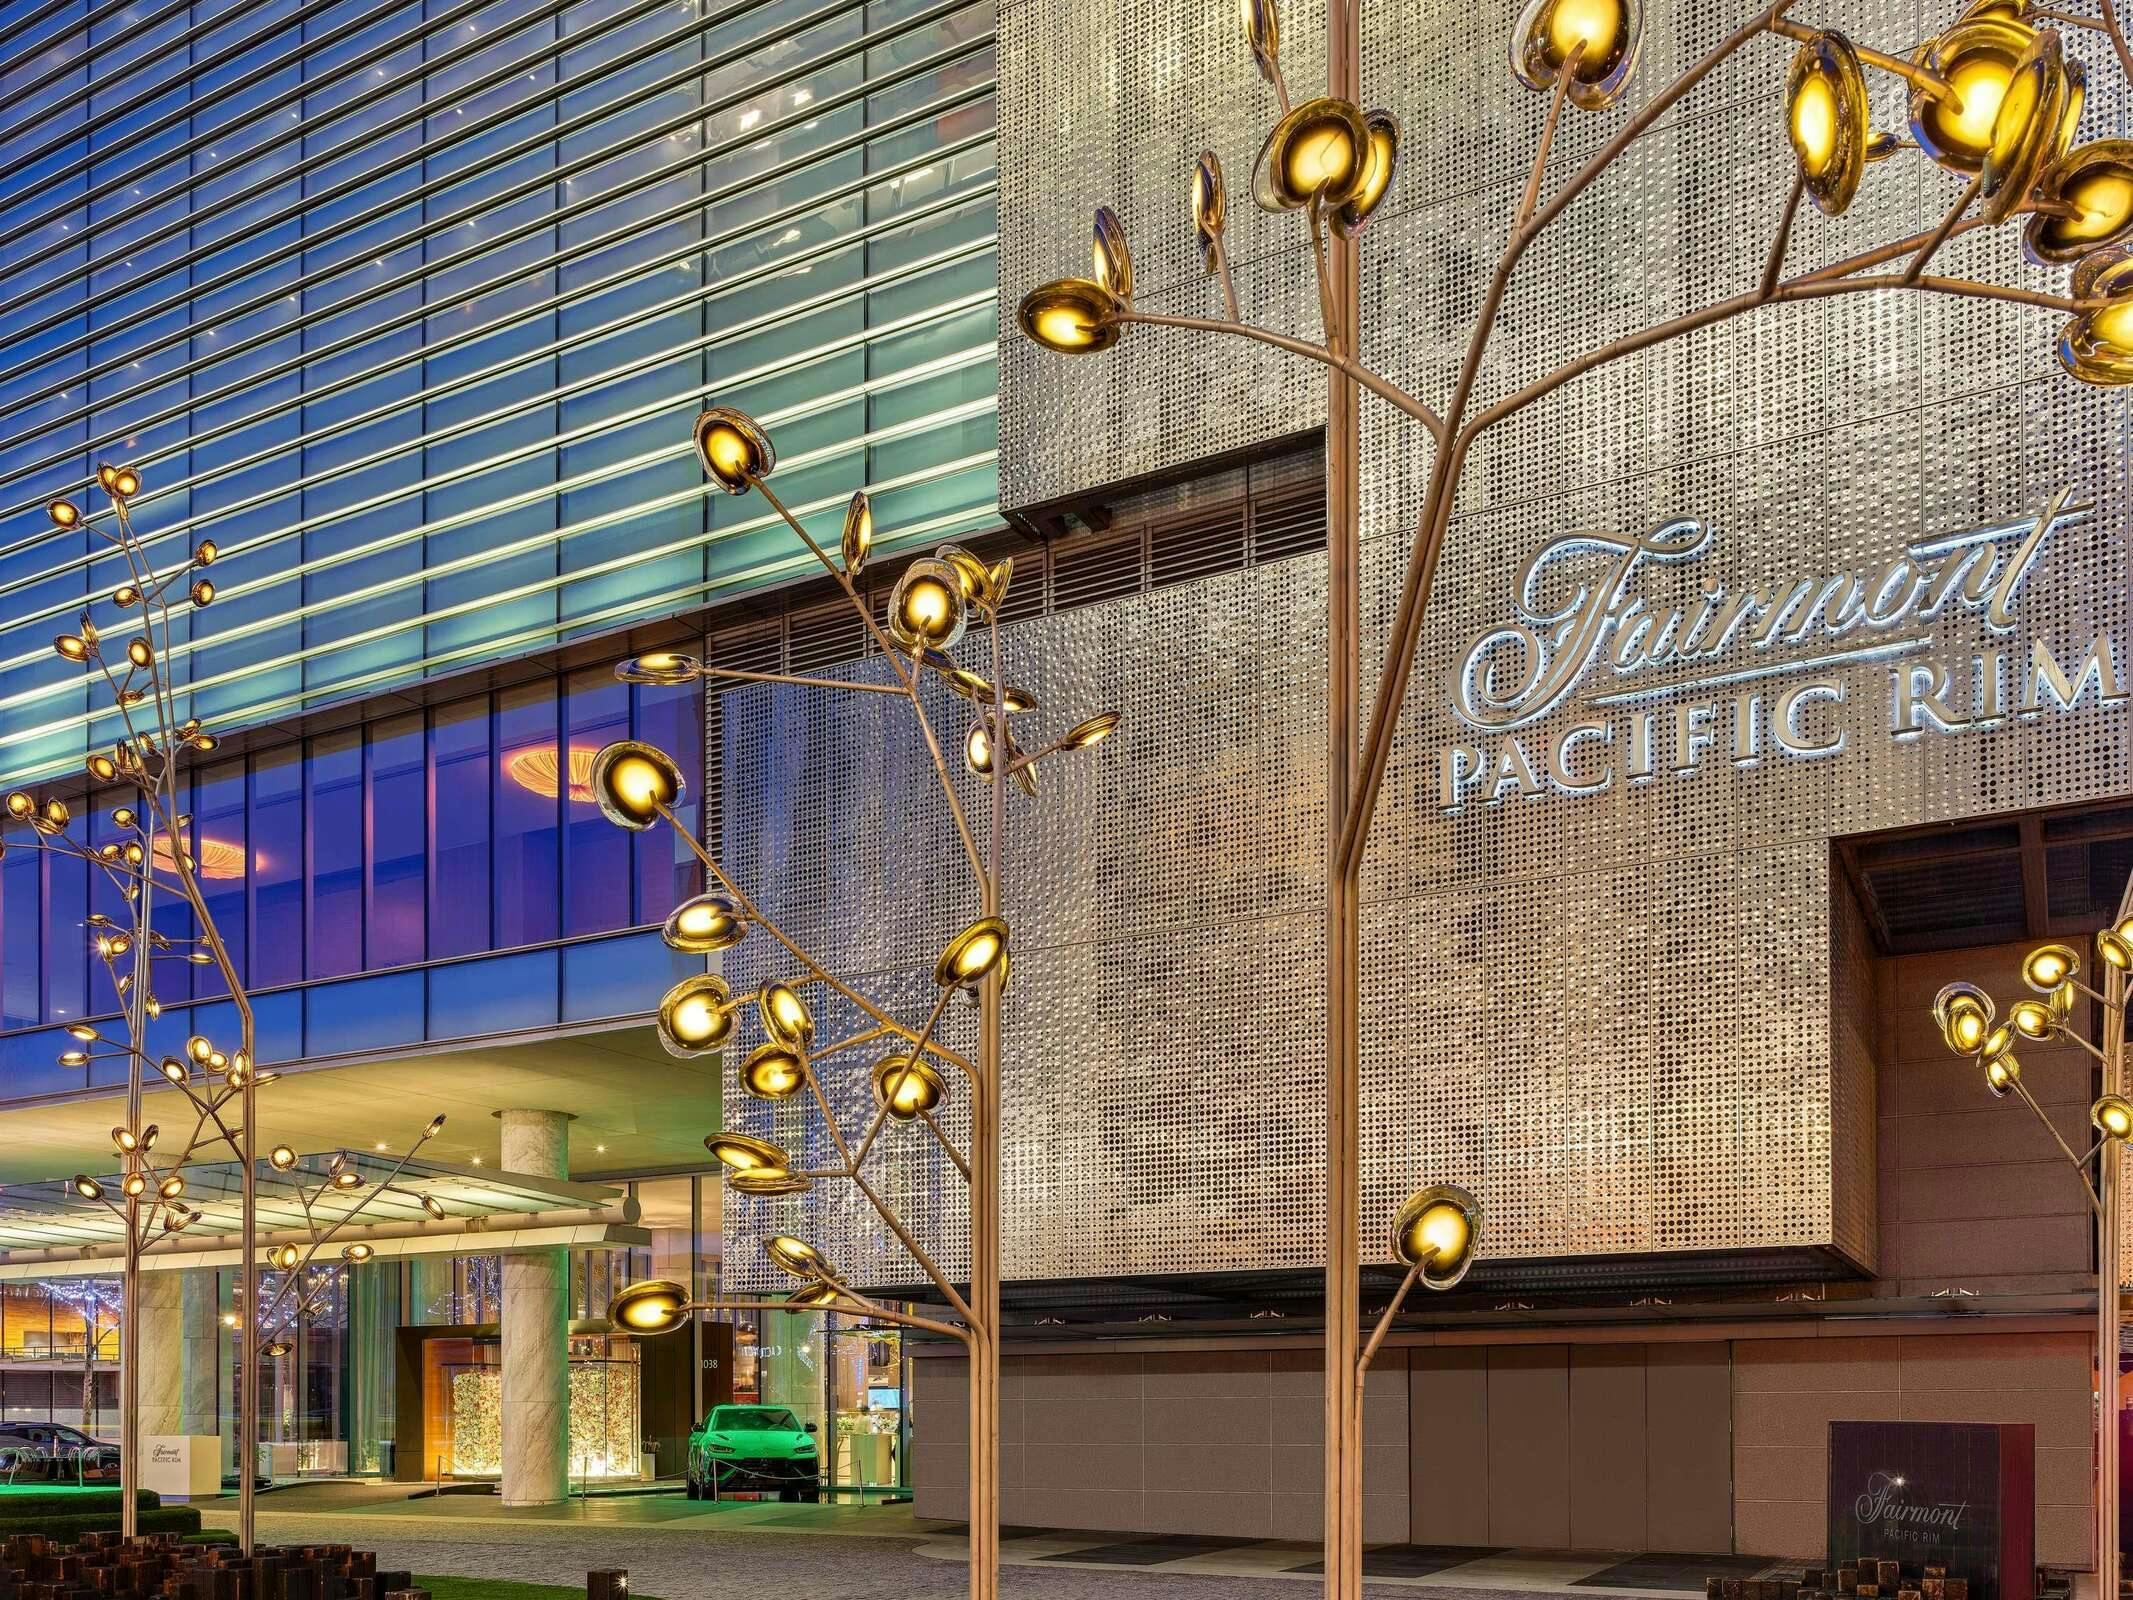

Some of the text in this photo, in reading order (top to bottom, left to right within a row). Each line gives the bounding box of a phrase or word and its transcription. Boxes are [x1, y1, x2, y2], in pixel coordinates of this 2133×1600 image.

[1449, 484, 2097, 729] Fairmont
[1435, 629, 2131, 813] PACIFIC RIM
[1855, 1471, 1971, 1530] Fairmont
[1884, 1528, 1941, 1545] PACIFIC RIM
